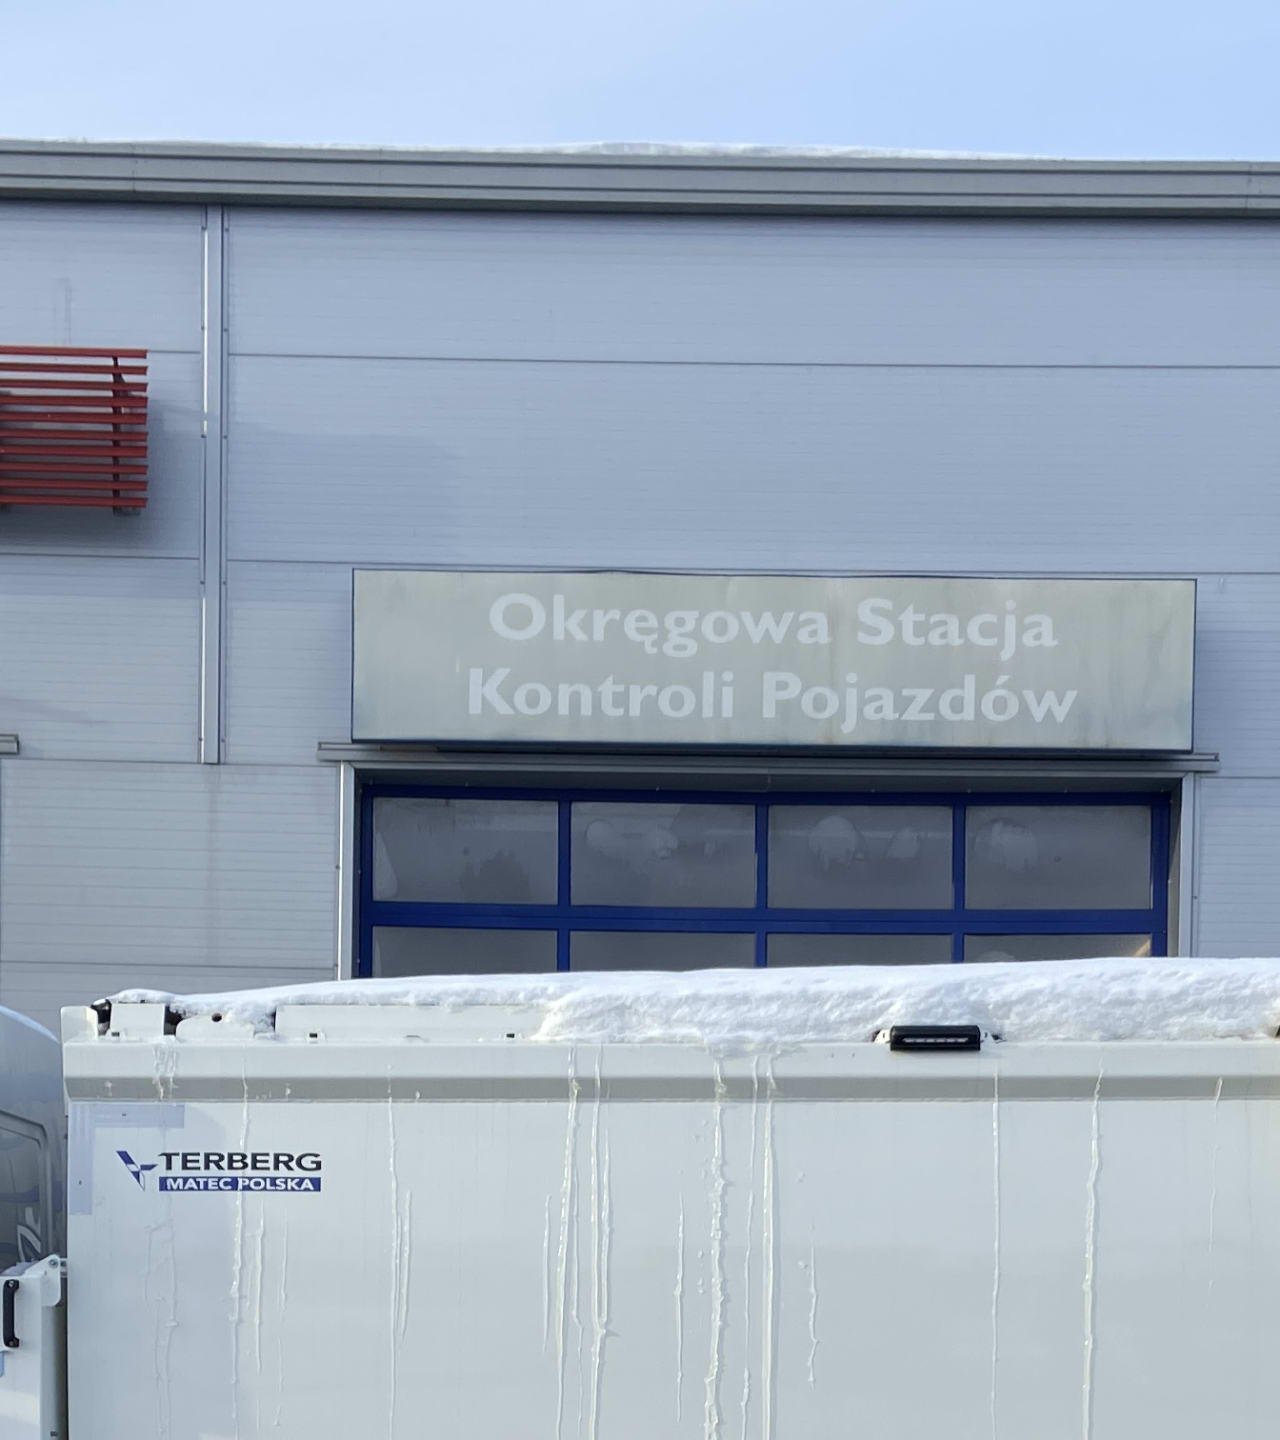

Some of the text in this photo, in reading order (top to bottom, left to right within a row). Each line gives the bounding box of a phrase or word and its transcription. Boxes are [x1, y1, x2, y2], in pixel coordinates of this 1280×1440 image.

[488, 592, 1058, 658] Okręgowa Stacja
[467, 667, 1079, 734] Kontroli Pojazdów
[158, 1152, 322, 1171] TERBERG
[166, 1177, 314, 1190] MATEC POLSKA
